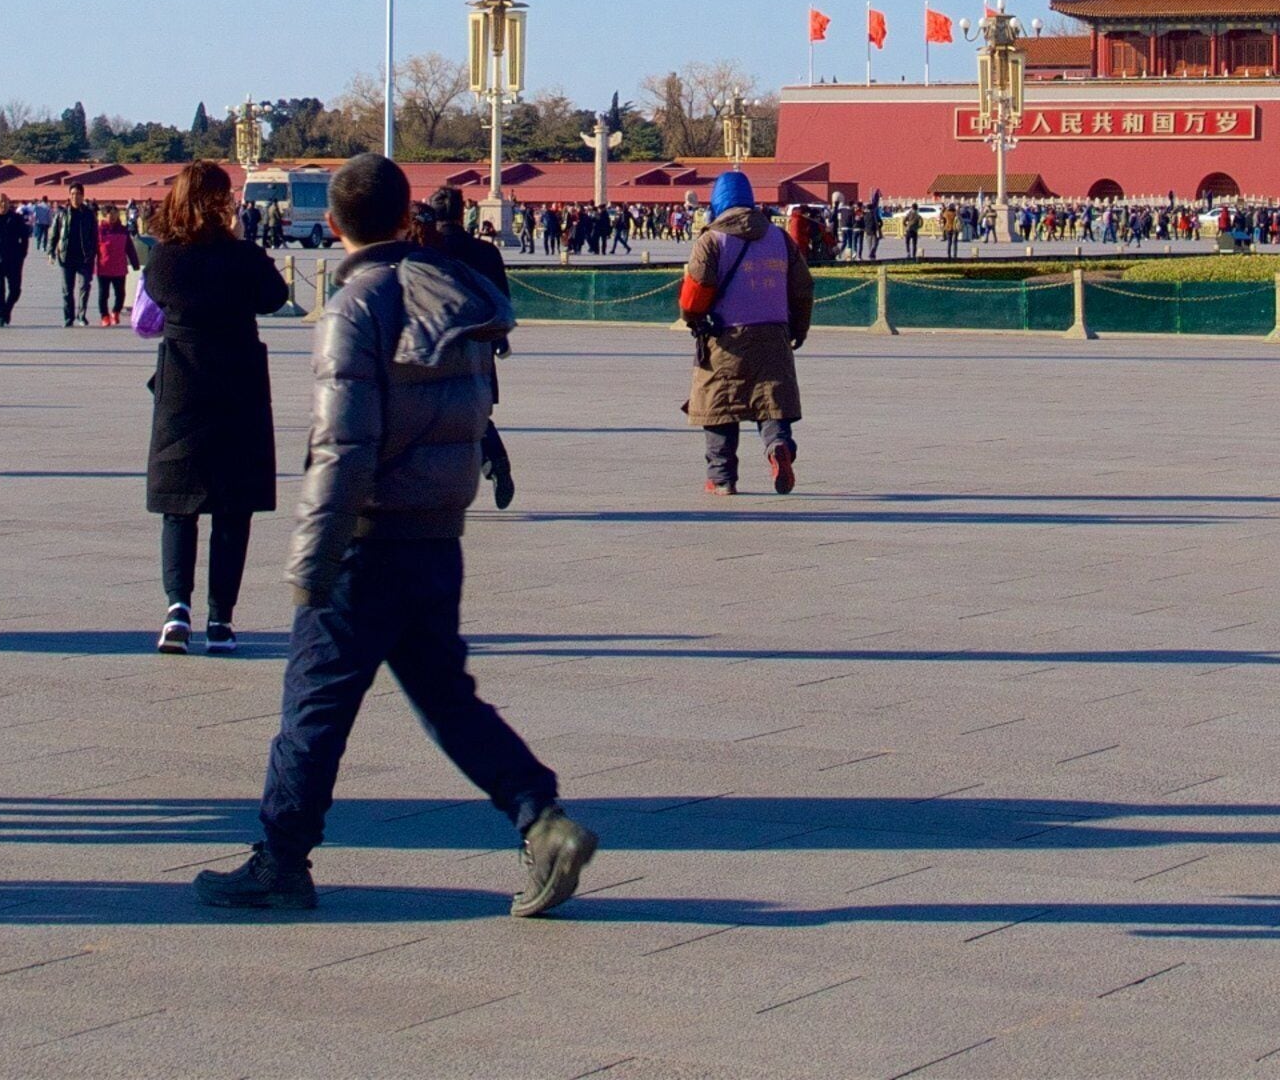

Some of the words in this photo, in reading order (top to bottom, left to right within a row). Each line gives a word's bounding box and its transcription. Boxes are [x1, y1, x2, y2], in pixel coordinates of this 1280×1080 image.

[970, 111, 1239, 134] 中华人民共和国万岁
